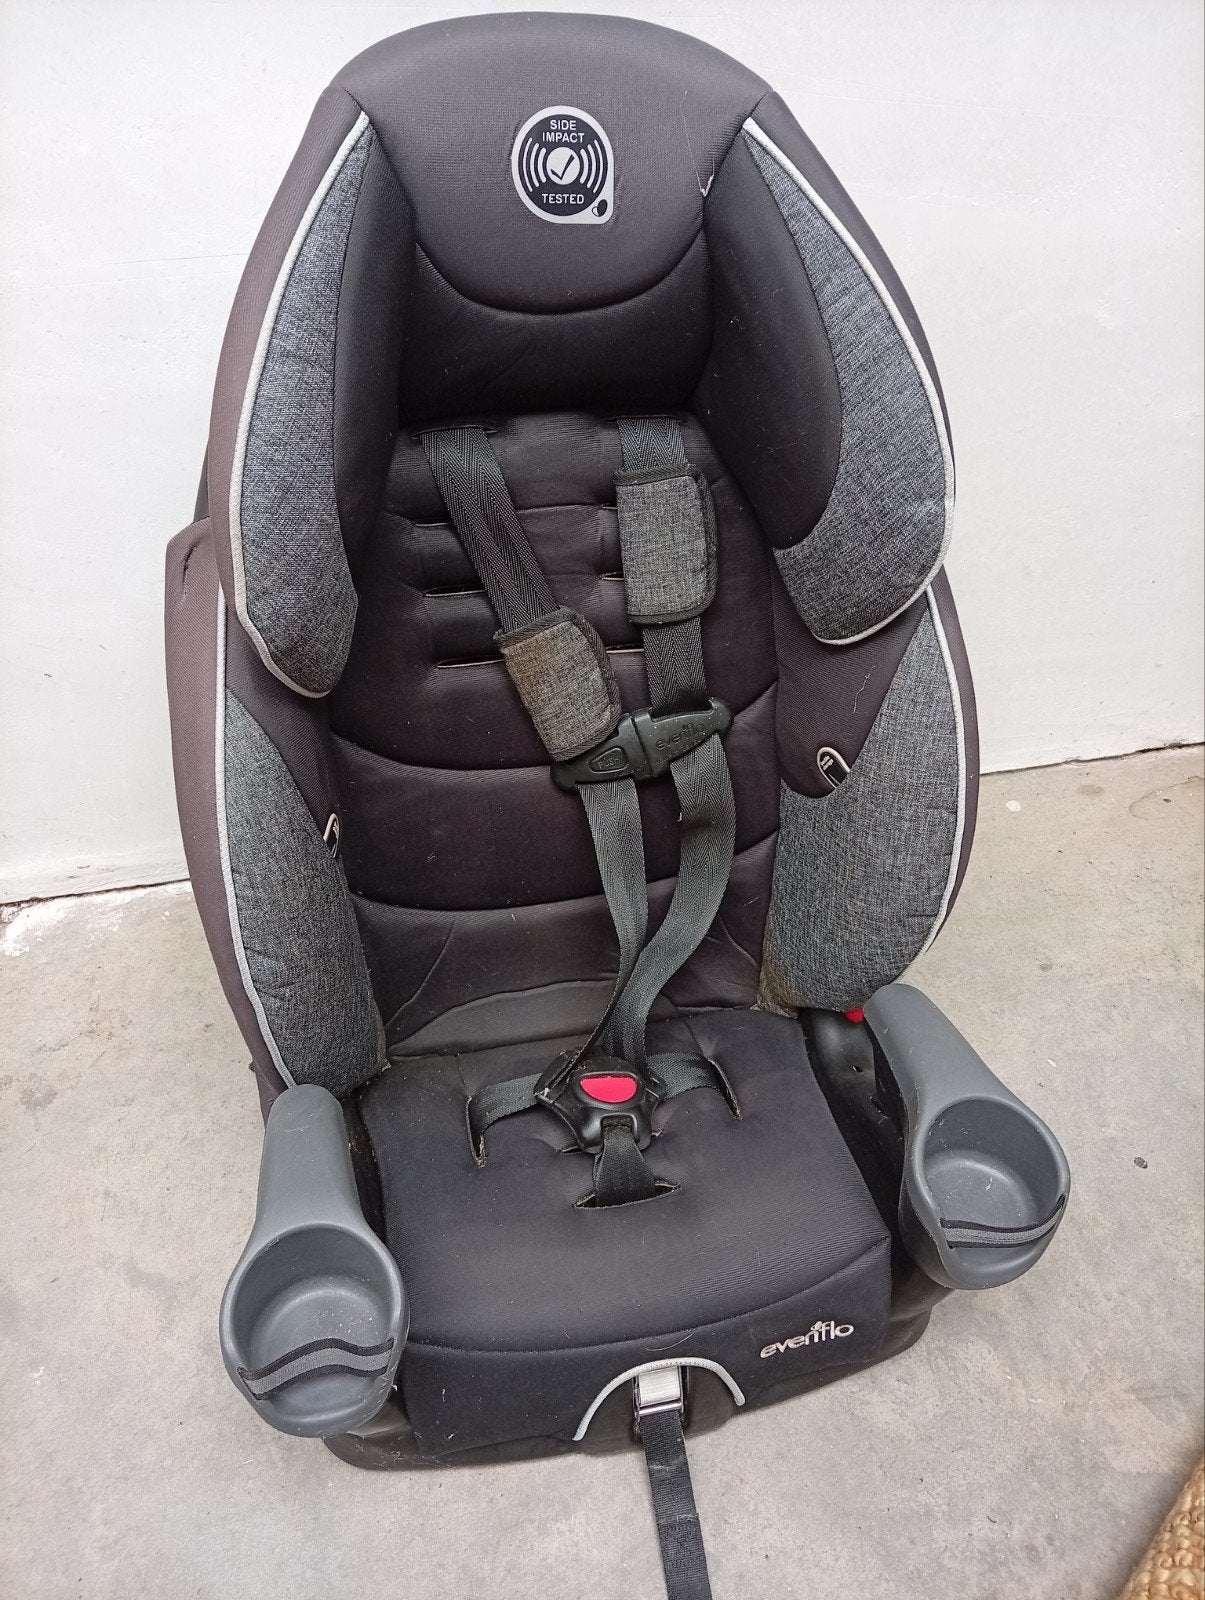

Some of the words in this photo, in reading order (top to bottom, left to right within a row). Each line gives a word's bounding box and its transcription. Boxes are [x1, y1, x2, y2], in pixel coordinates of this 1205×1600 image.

[549, 119, 577, 131] SIDE
[542, 131, 585, 143] IMPACT
[541, 193, 585, 204] TESTED
[655, 722, 705, 750] evenflo
[597, 755, 622, 769] PUSH
[760, 1320, 855, 1358] evenflo
